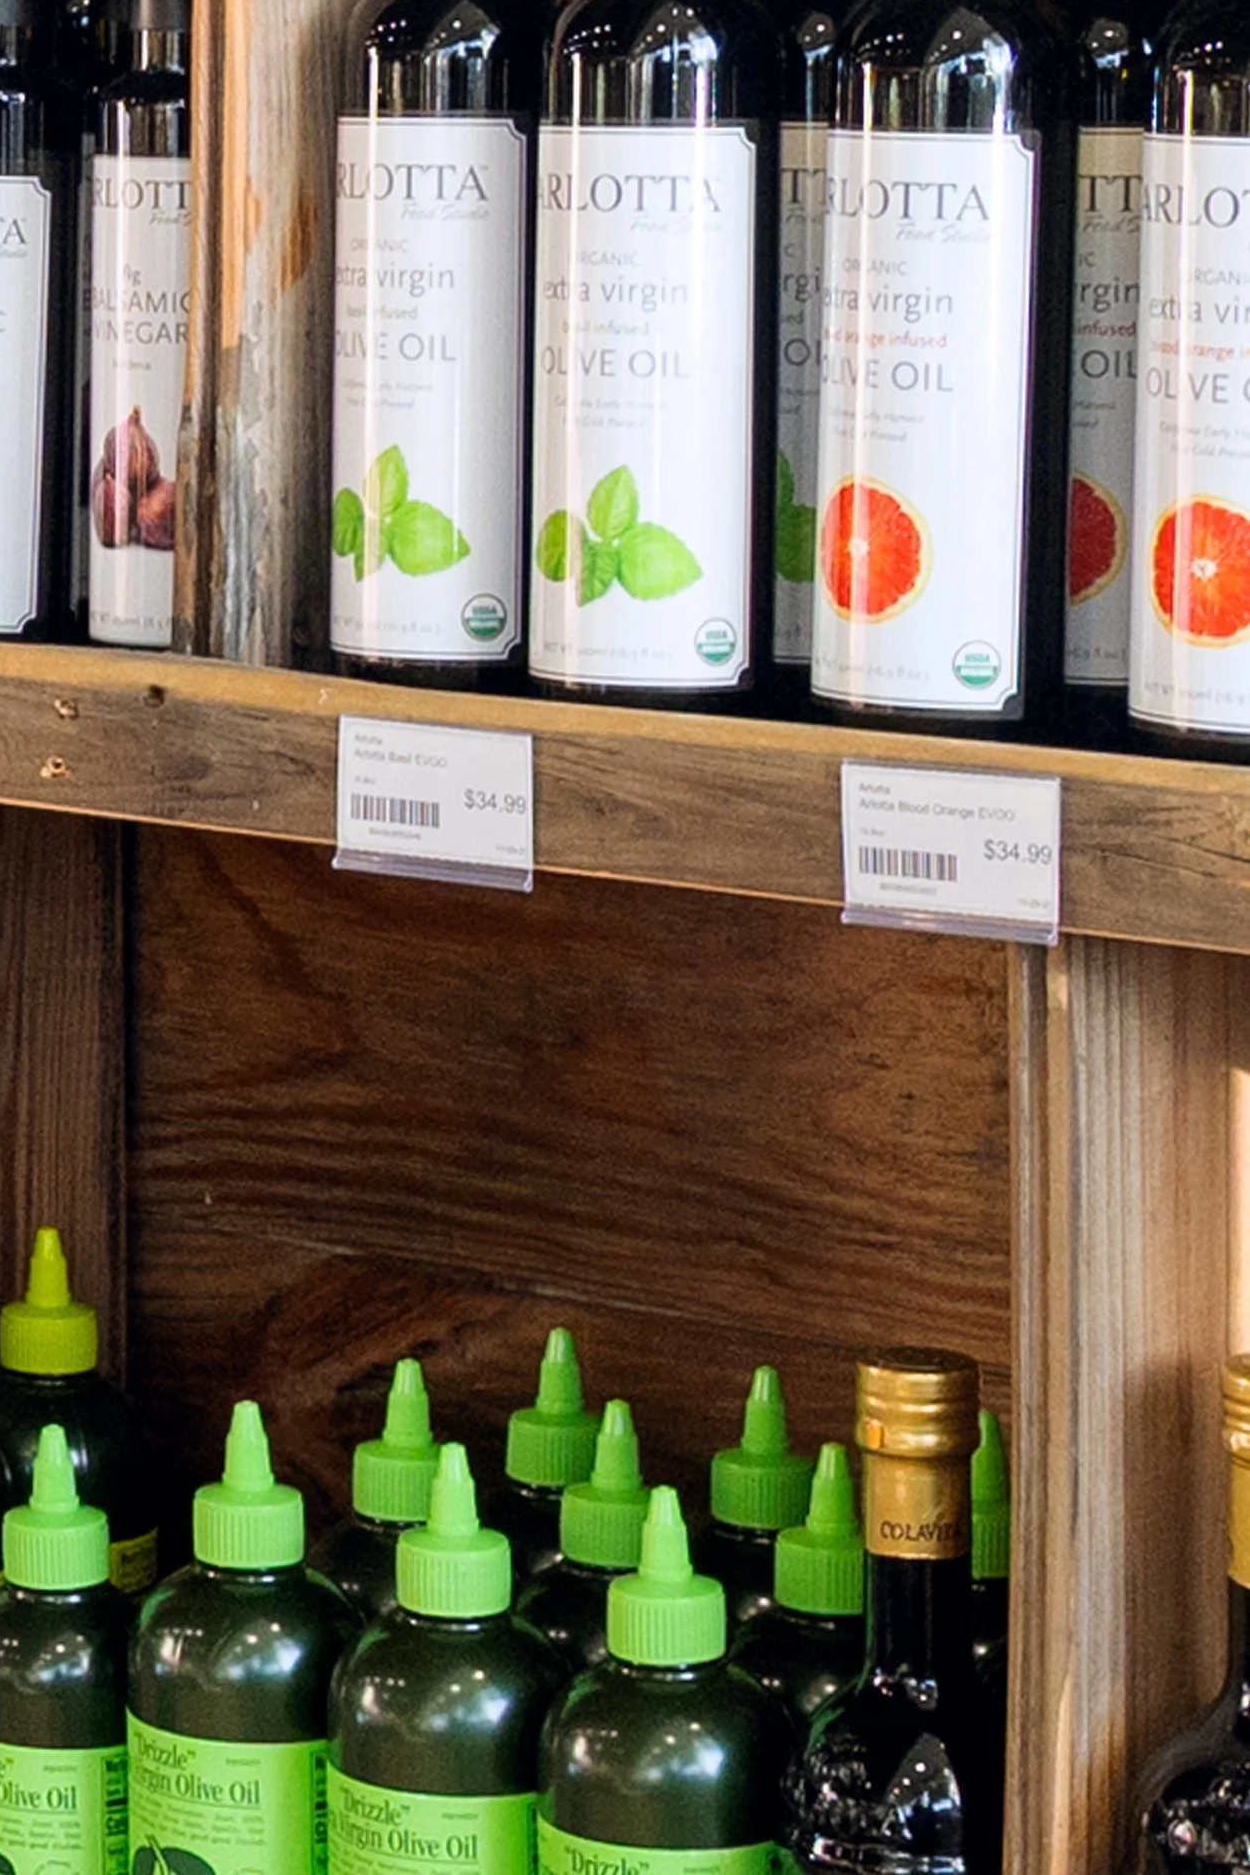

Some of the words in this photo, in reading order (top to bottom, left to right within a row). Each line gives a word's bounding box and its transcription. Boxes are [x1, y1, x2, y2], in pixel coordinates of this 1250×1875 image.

[377, 264, 456, 297] virgin
[601, 276, 688, 311] virgin
[868, 287, 953, 324] virgin
[398, 332, 458, 362] OIL
[629, 349, 690, 380] OIL
[891, 361, 954, 393] OIL
[463, 787, 527, 816] $34.99
[983, 838, 1052, 865] $34.99
[46, 1784, 78, 1811] Oil
[174, 1773, 225, 1804] Olive
[229, 1777, 261, 1806] Oil
[386, 1828, 441, 1859] Olive
[445, 1832, 479, 1861] Oil
